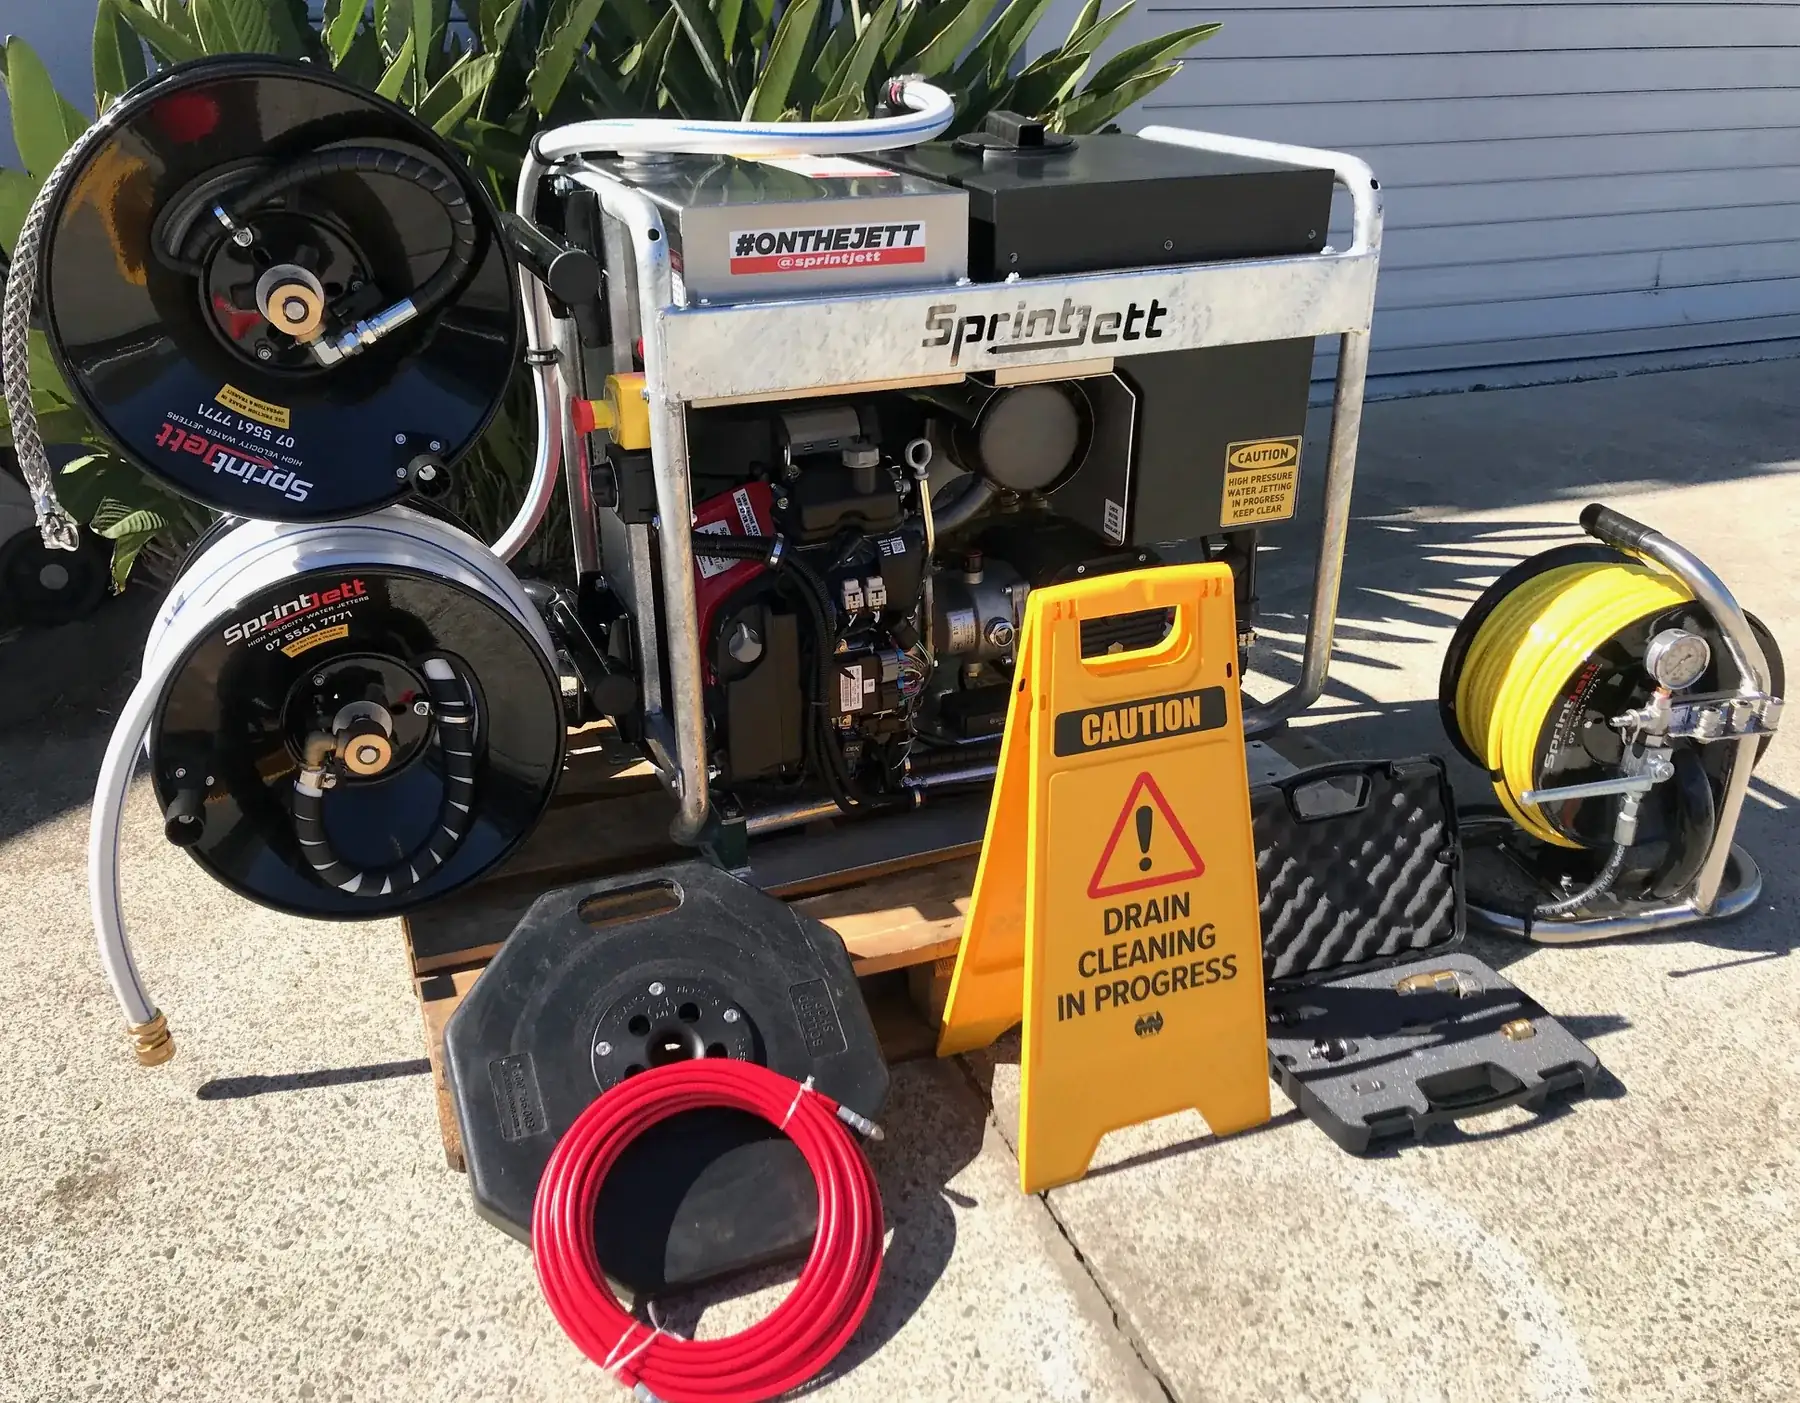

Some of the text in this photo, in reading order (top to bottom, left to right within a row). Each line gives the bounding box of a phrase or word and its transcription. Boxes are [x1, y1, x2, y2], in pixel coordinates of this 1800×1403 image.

[735, 224, 921, 257] #ONTHEJETT
[777, 251, 882, 270] @sprintjett
[167, 411, 304, 467] HIGH VELOCITY WATER JETTERS
[197, 403, 296, 449] 07 5561 7771
[1237, 447, 1289, 464] CAUTION
[1227, 482, 1292, 497] WATER JETTING
[1228, 471, 1294, 487] HIGH PRESSURE
[1231, 493, 1285, 508] IN PROGRESS
[1232, 504, 1282, 519] KEEP CLEAR
[247, 595, 370, 649] HIGH VELOCITY WATER JETTERS
[265, 610, 354, 652] 07 5561 7771
[1081, 695, 1201, 747] CAUTION
[1103, 891, 1190, 937] DRAIN
[1078, 922, 1217, 979] CLEANING
[1057, 953, 1238, 1022] IN PROGRESS
